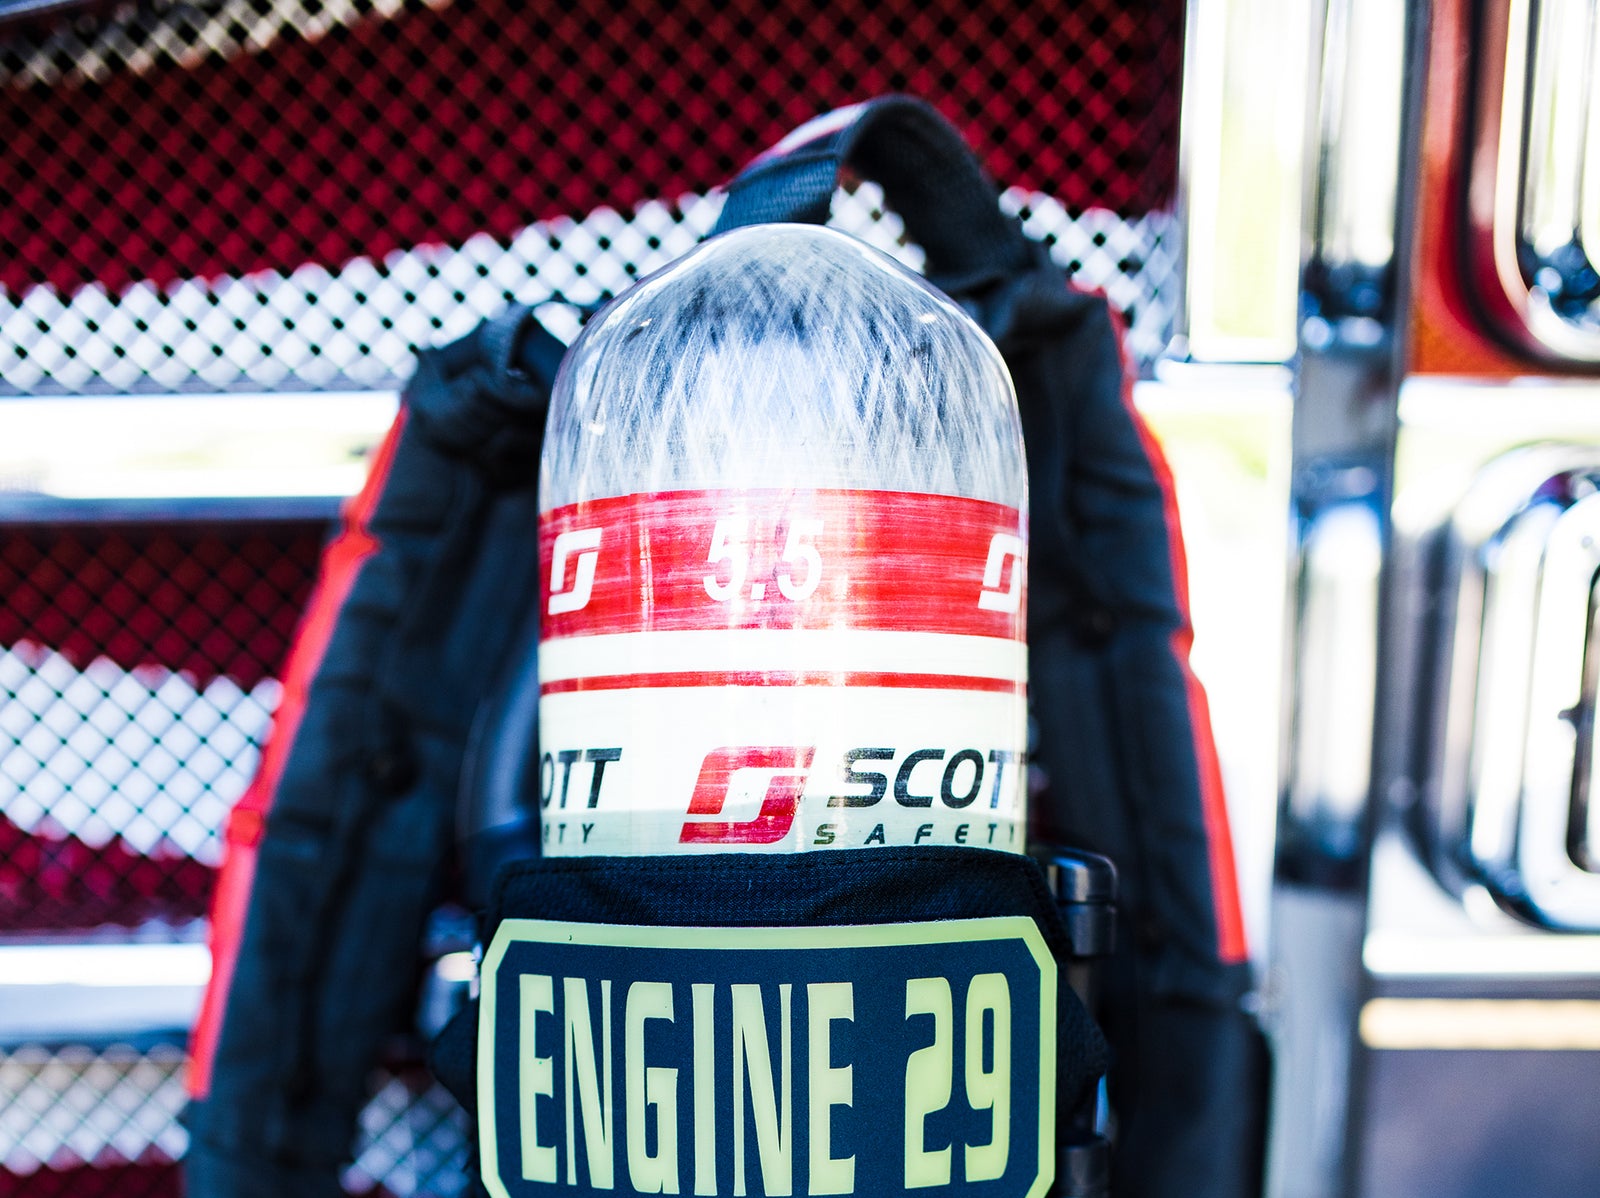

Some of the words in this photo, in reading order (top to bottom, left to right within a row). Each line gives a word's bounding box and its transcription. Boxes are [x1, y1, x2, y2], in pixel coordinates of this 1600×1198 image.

[703, 519, 824, 601] 5.5
[519, 973, 855, 1197] ENGINE
[904, 973, 1012, 1190] 29
